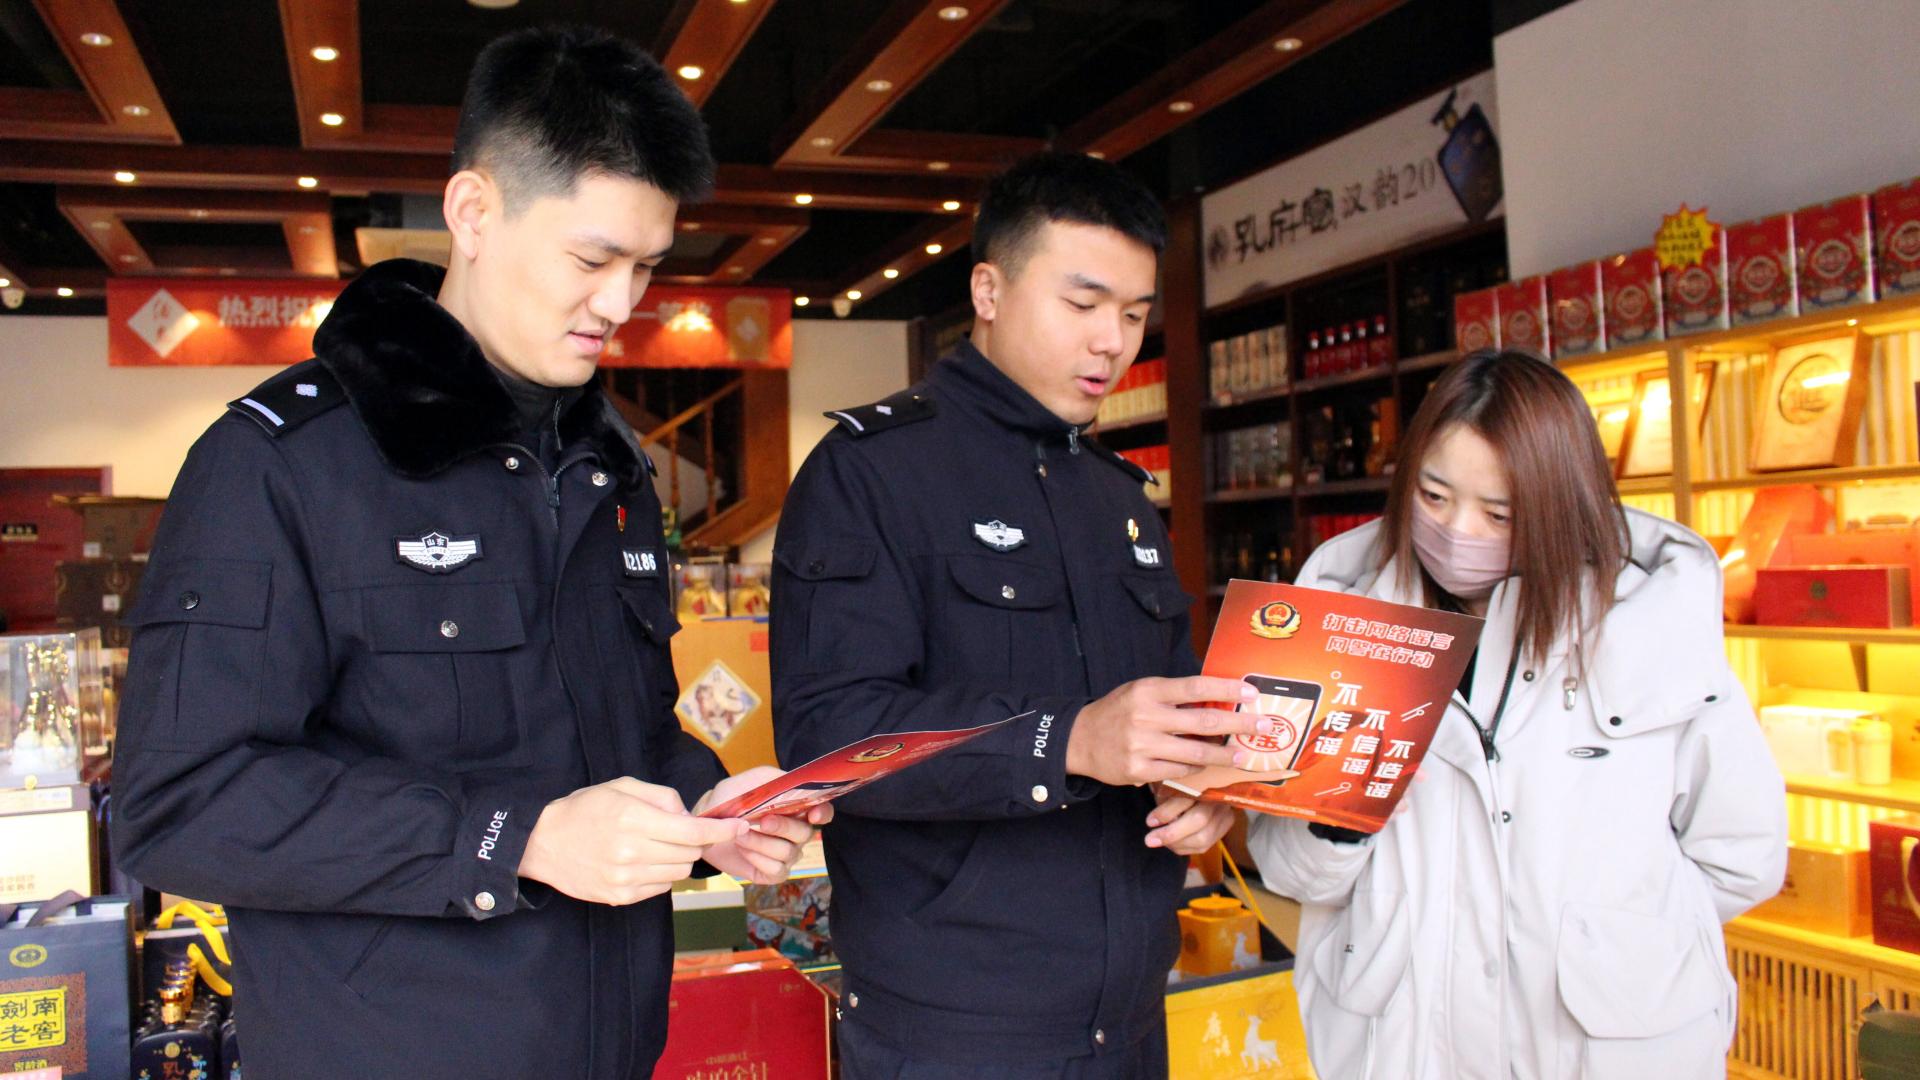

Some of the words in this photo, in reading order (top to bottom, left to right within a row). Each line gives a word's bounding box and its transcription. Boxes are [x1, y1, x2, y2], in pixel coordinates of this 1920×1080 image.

[1322, 613, 1455, 650] 打击网络谣言
[1325, 635, 1435, 669] 网警在行动
[1033, 714, 1055, 758] POLICE
[1314, 682, 1363, 756] 不传谣
[1341, 708, 1391, 775] 不信谣
[1364, 739, 1416, 799] 不造谣
[477, 810, 508, 861] POLICE
